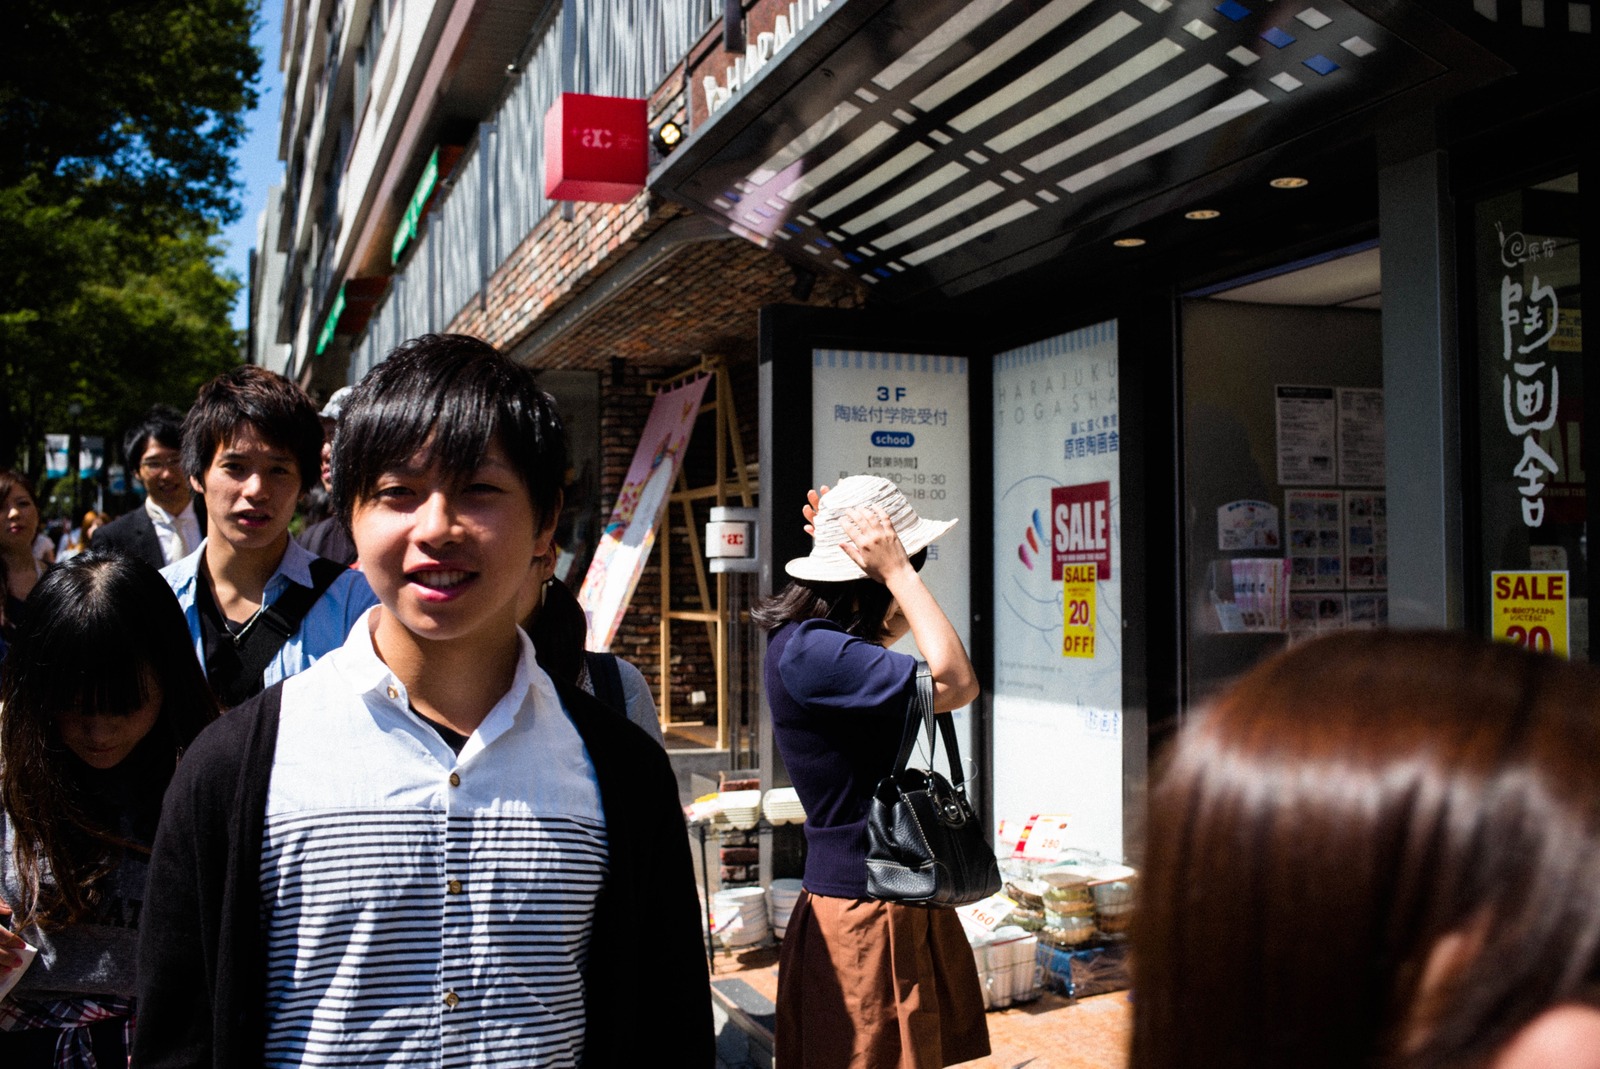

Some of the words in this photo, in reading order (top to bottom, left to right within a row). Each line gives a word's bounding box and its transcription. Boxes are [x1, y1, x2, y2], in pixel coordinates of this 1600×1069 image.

[998, 357, 1117, 405] HARAJUKU
[834, 404, 948, 426] 陶絵付学院受付
[998, 386, 1118, 428] TOGASHA
[875, 435, 911, 446] school
[1064, 430, 1119, 460] 原宿陶画舎
[1055, 501, 1107, 553] SALE
[1065, 565, 1095, 583] SALE
[1495, 576, 1564, 600] SALE
[1063, 635, 1095, 654] OFF!
[970, 908, 995, 926] 160
